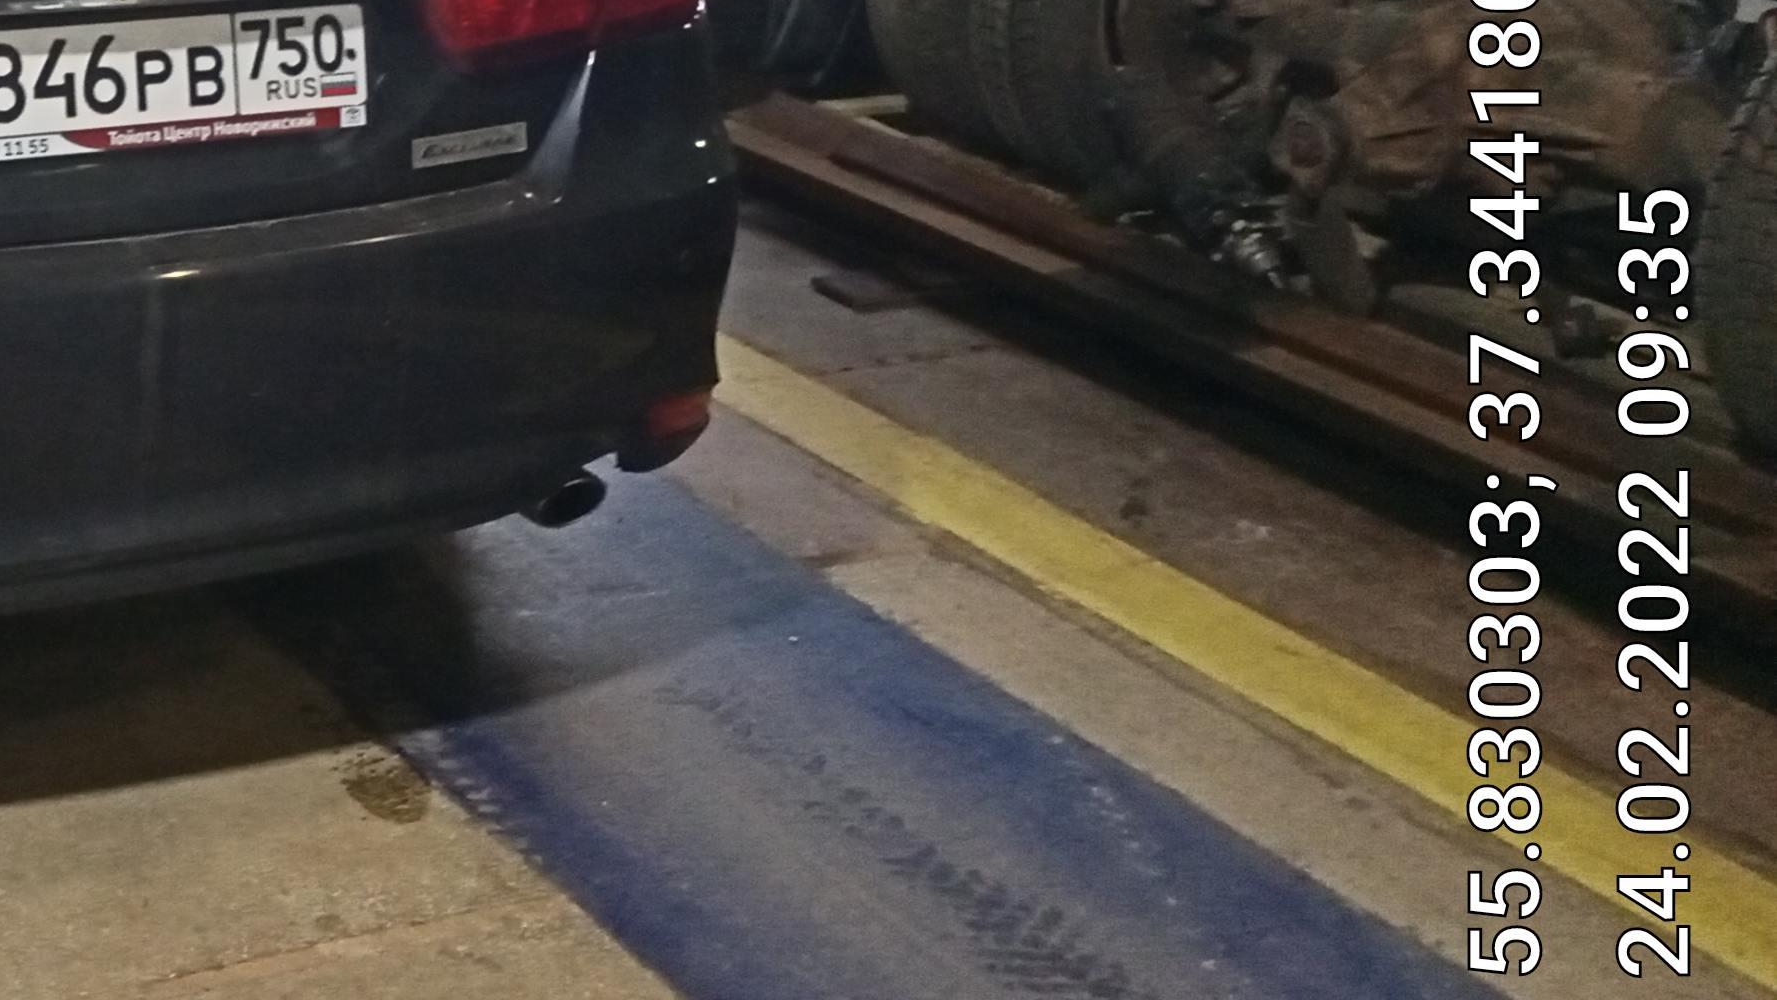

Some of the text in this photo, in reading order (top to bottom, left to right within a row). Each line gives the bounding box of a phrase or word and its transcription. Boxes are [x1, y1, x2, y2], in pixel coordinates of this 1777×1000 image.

[240, 13, 344, 80] 750
[266, 77, 318, 101] RUS
[107, 129, 161, 146] Тойота
[163, 123, 211, 142] Центр
[4, 140, 24, 157] 11
[27, 137, 50, 154] 55
